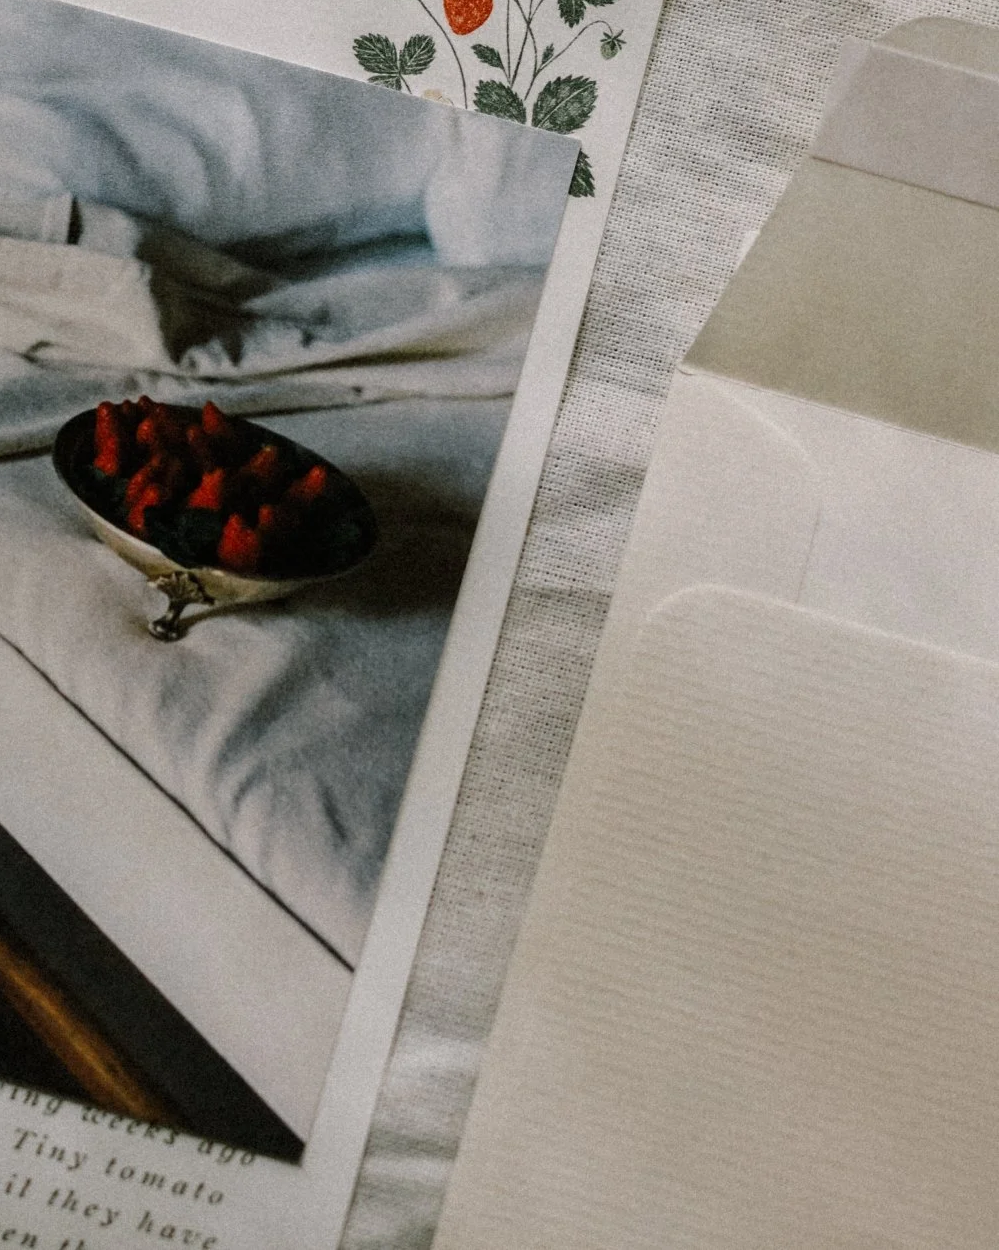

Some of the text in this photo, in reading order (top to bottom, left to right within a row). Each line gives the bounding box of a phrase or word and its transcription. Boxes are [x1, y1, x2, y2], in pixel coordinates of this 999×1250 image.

[12, 1128, 89, 1172] Tiny
[104, 1156, 225, 1206] tomato
[47, 1187, 122, 1227] they
[136, 1209, 219, 1250] have
